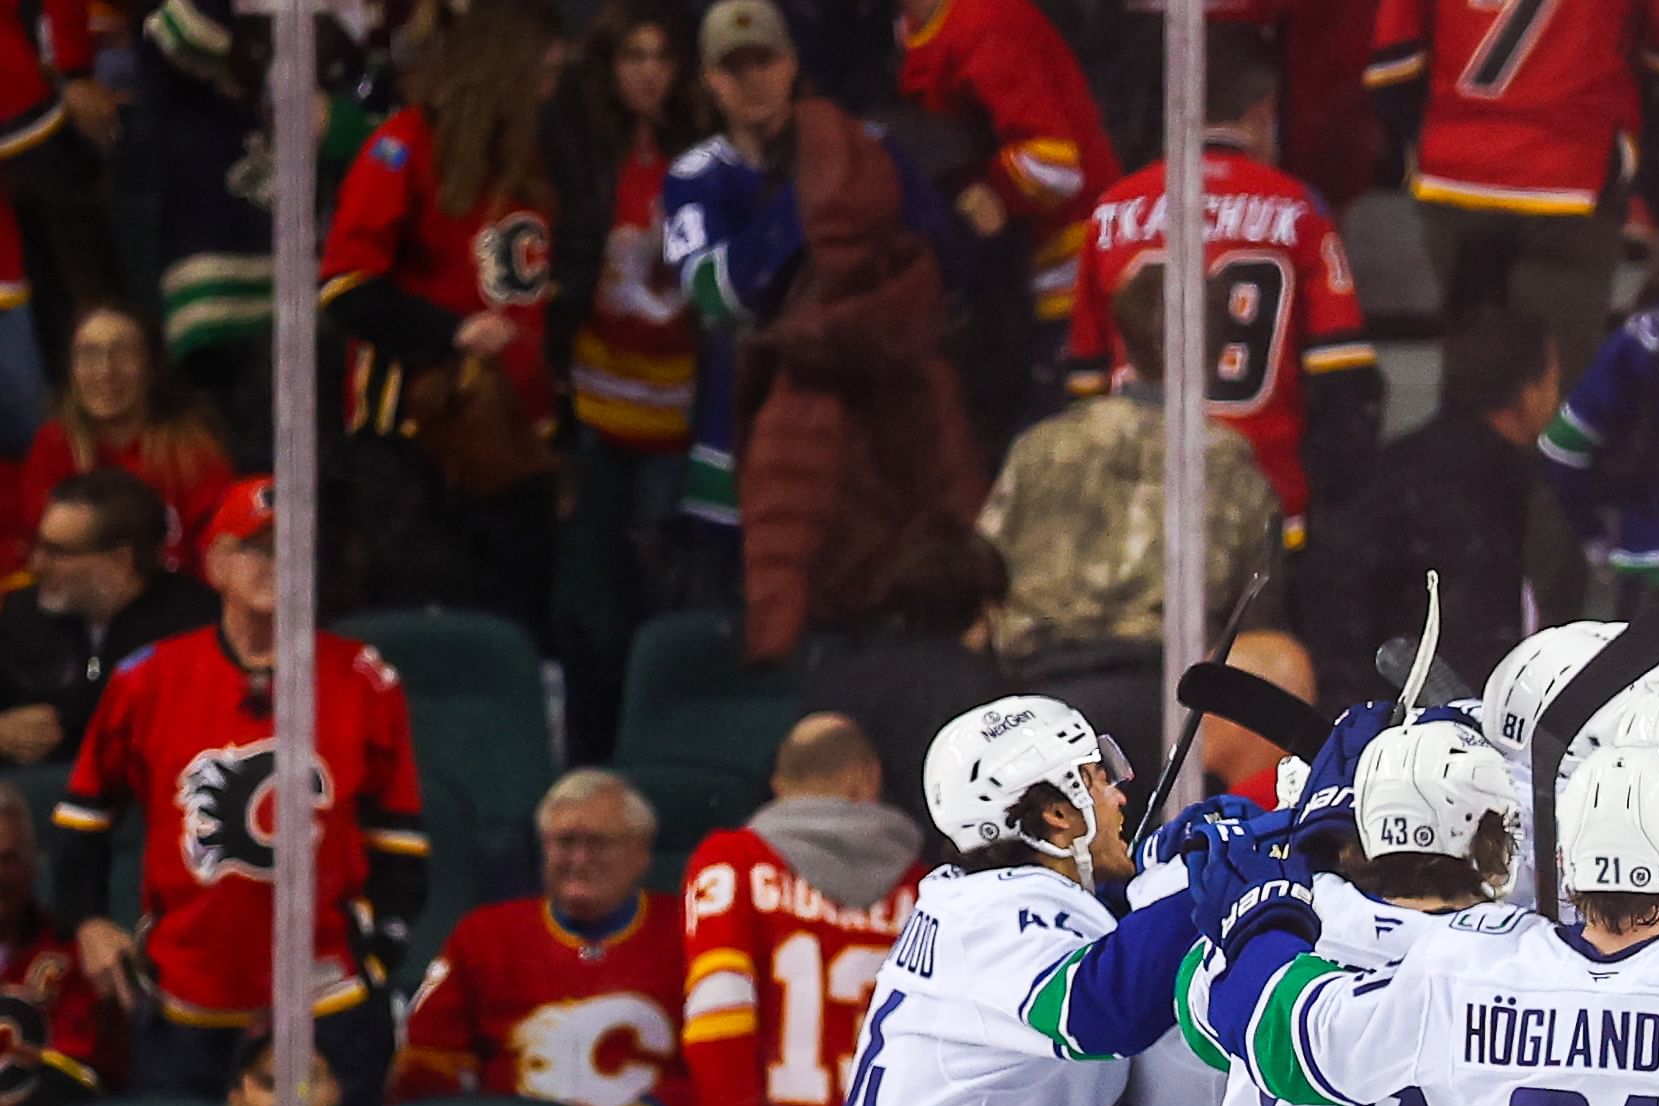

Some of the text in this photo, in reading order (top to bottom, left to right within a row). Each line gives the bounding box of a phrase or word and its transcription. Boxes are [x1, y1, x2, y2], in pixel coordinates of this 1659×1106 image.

[981, 709, 1036, 743] NexGen
[1502, 713, 1526, 744] 81
[1381, 817, 1408, 846] 43
[1594, 856, 1620, 885] 21
